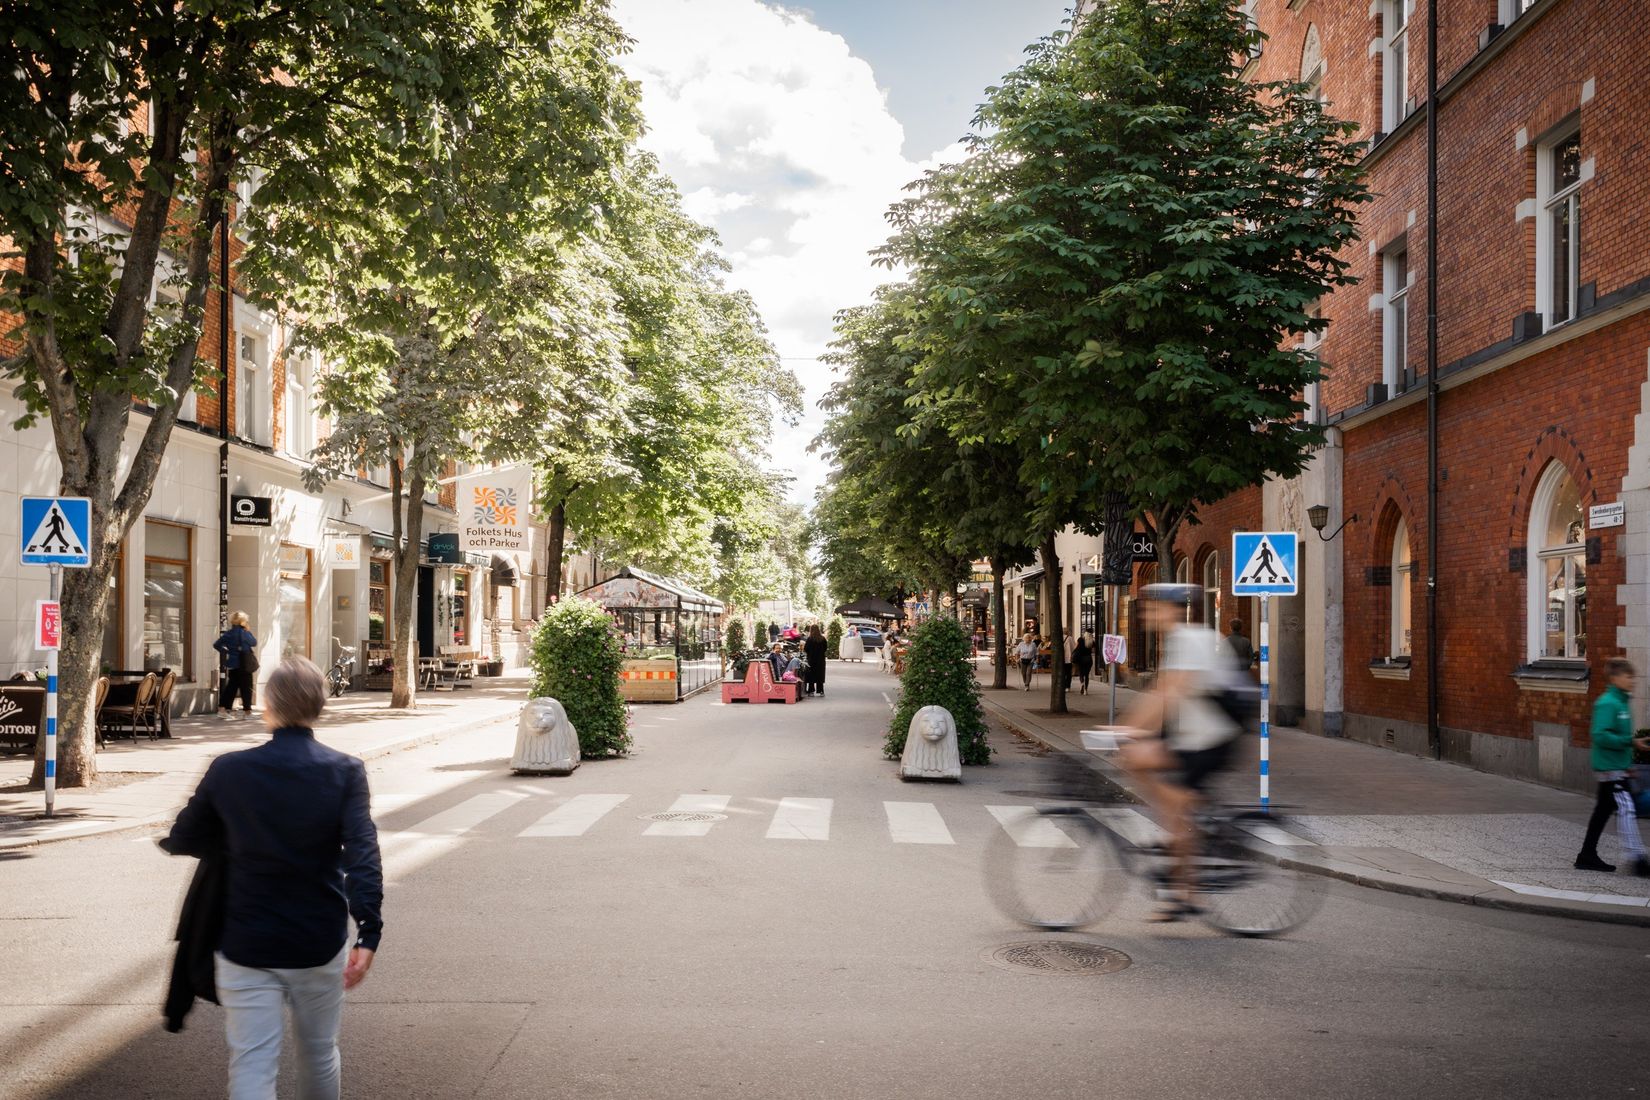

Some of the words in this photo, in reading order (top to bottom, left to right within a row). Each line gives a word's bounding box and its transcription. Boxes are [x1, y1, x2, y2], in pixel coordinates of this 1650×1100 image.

[466, 527, 502, 536] Folkets
[504, 528, 522, 538] Hus
[469, 537, 487, 546] och
[489, 538, 520, 548] Parker
[1546, 613, 1559, 623] REA
